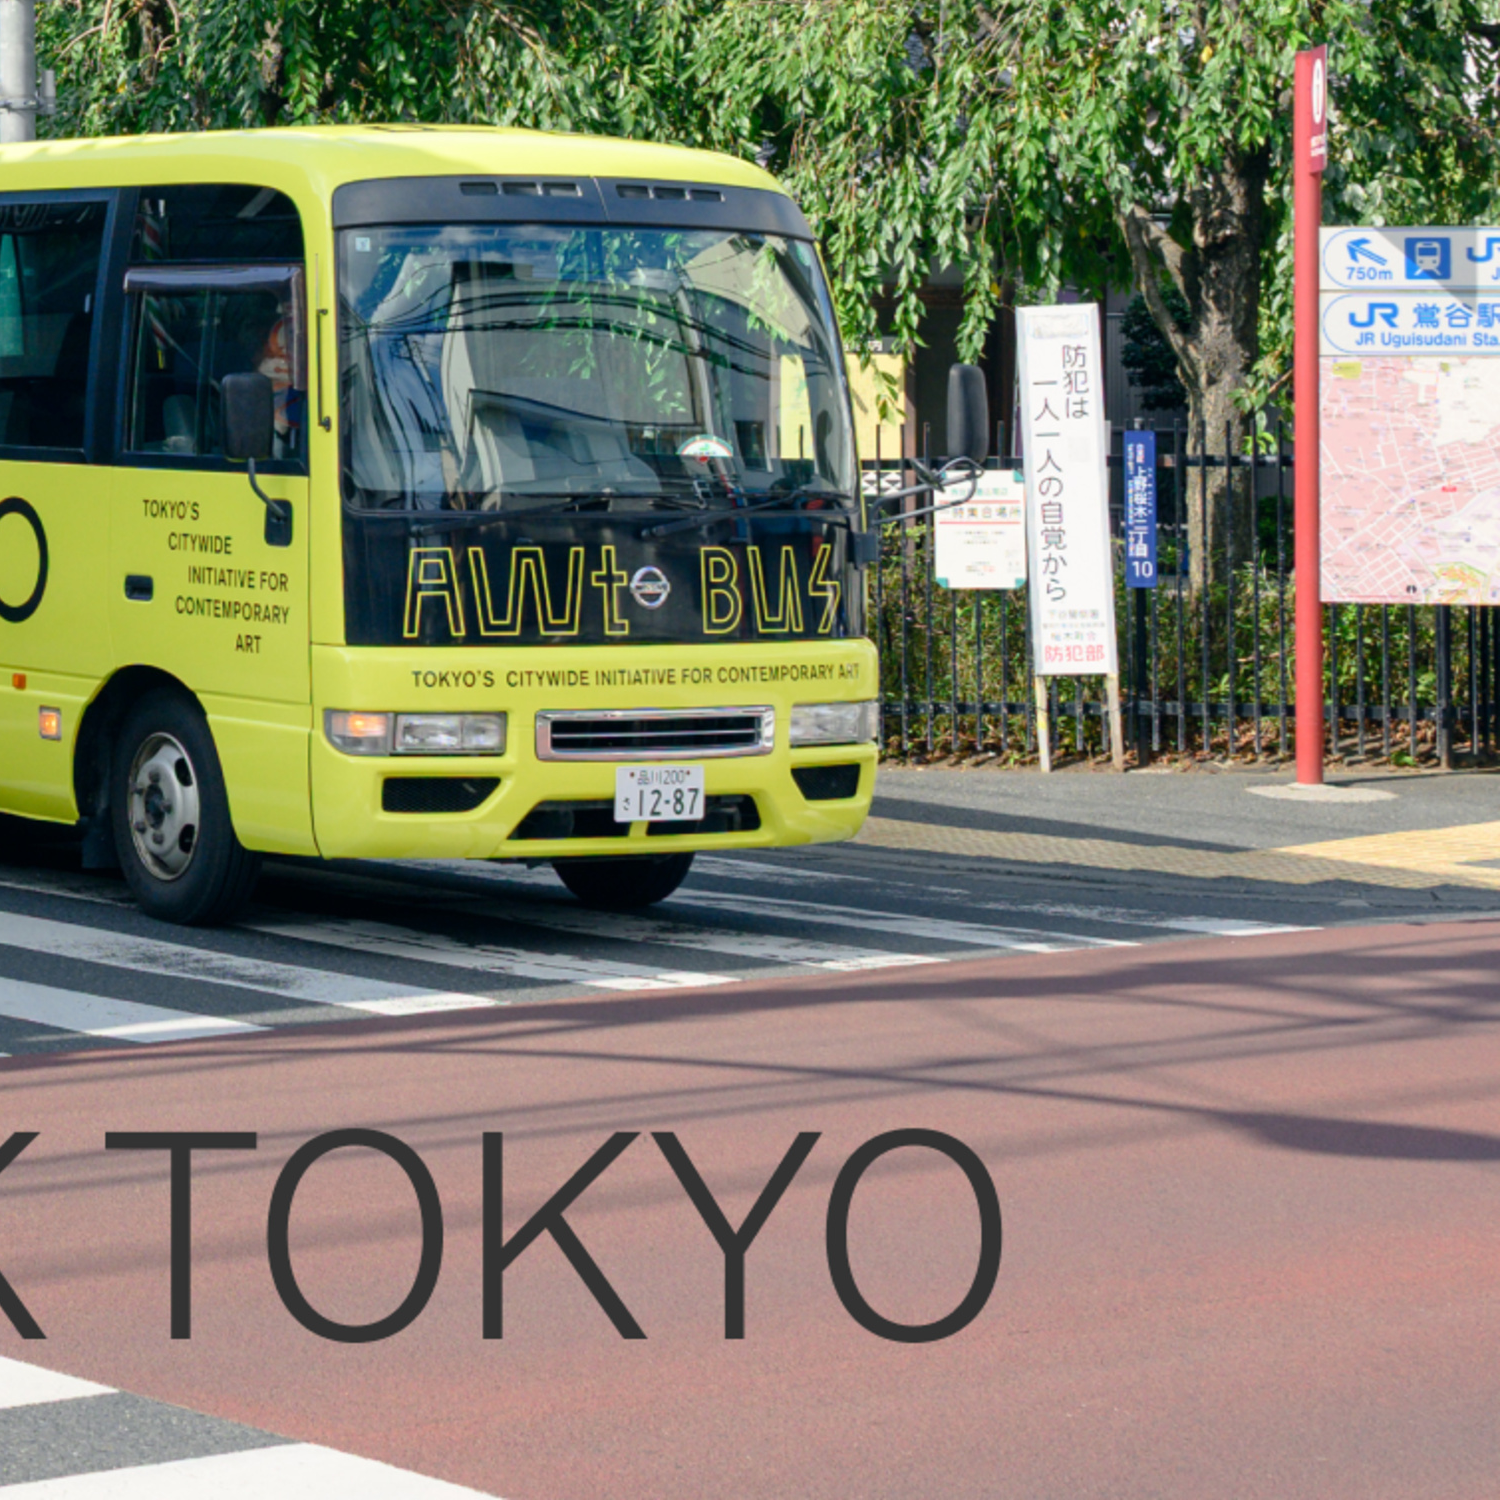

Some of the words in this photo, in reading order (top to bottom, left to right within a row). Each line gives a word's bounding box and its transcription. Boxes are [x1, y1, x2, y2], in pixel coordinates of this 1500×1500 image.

[1346, 267, 1393, 281] 750m
[1348, 302, 1399, 328] JR
[1355, 332, 1375, 346] JR
[1381, 332, 1467, 348] Uguisudani
[1062, 344, 1090, 419] 防犯は
[1032, 379, 1068, 602] 一人一人の自覚から
[143, 499, 200, 521] TOKYO'S
[168, 532, 232, 555] CITYWIDE
[188, 565, 256, 589] INITIATIVE
[260, 571, 289, 593] FOR
[1131, 560, 1153, 578] 10
[175, 595, 290, 625] CONTEMPORARY
[235, 633, 262, 654] ART
[1044, 644, 1105, 663] 防犯部
[411, 669, 496, 688] TOKYO'S
[506, 669, 590, 688] CITYWIDE
[595, 667, 677, 686] INITIATIVE
[681, 667, 713, 684] FOR
[717, 663, 834, 684] CONTEMPORARY
[838, 662, 860, 680] ART
[638, 787, 700, 817] 12-87
